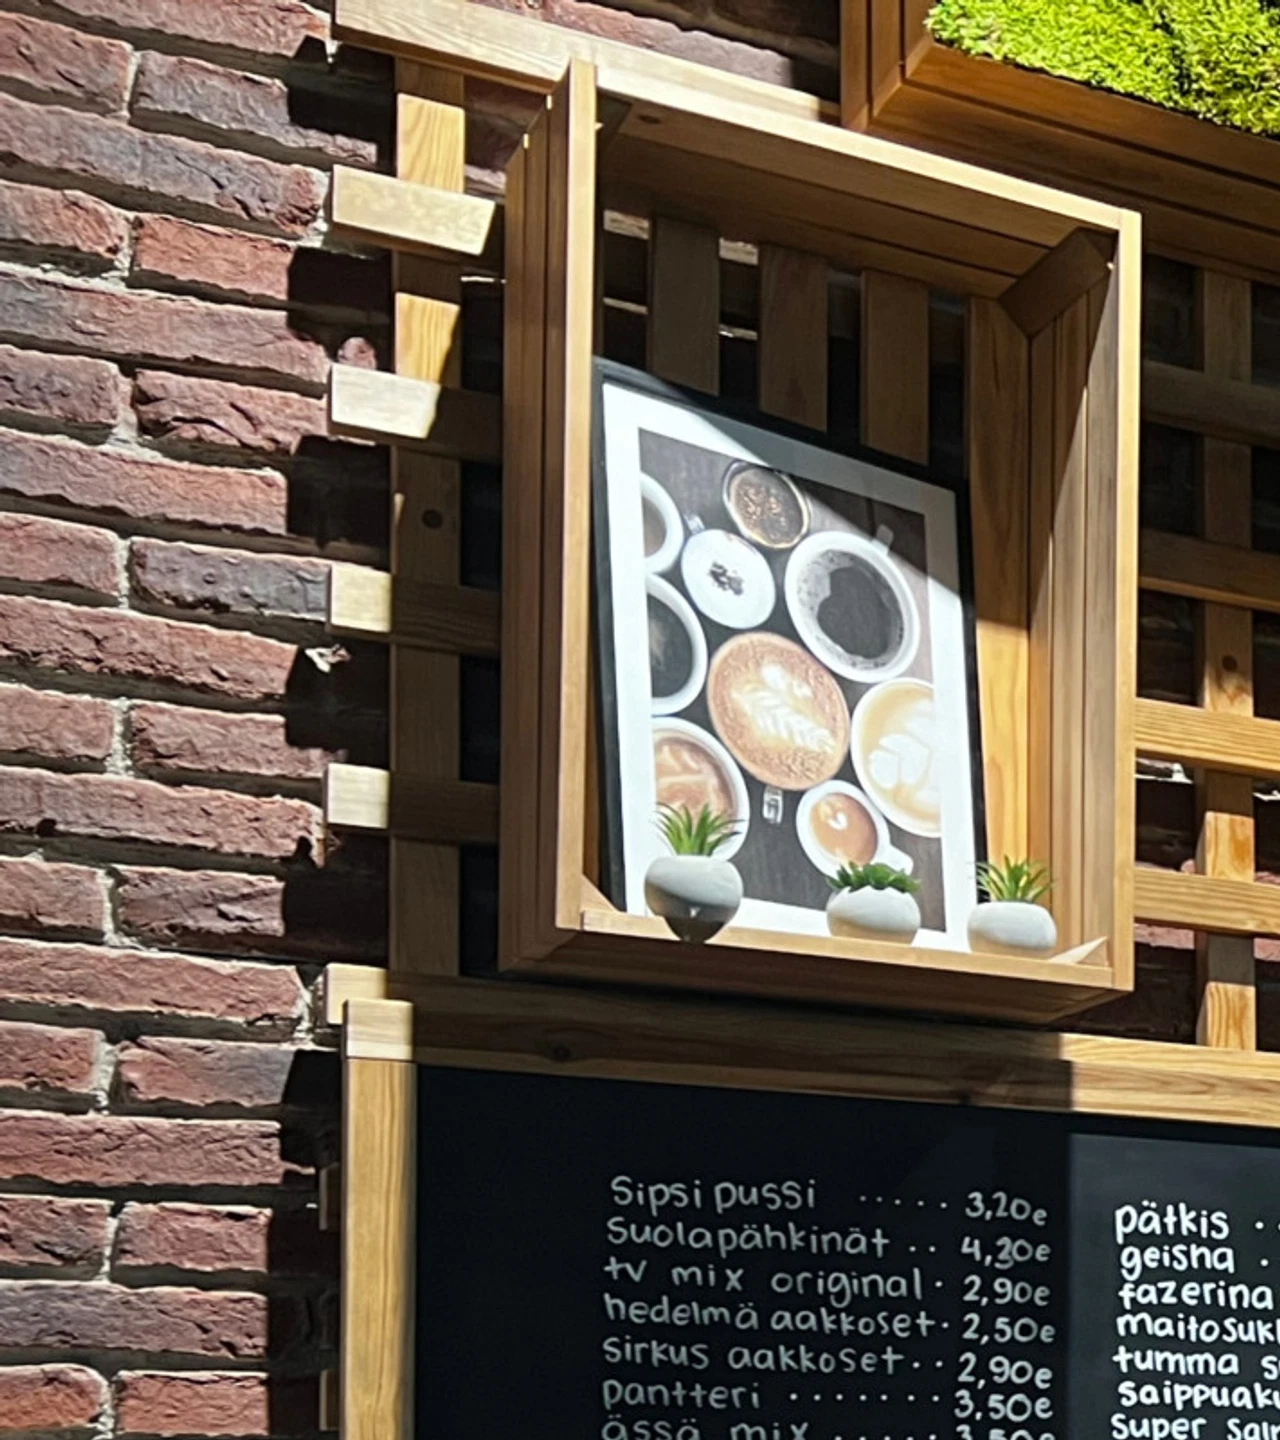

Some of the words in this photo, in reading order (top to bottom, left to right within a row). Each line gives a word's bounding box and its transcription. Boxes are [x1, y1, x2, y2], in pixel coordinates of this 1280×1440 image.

[964, 1190, 1048, 1226] 3,20e
[1114, 1200, 1230, 1244] pätkis
[1120, 1242, 1235, 1279] geisha
[604, 1257, 647, 1282] tv
[671, 1262, 743, 1292] mix
[770, 1268, 923, 1307] original
[963, 1275, 1051, 1307] 2,90e
[1118, 1279, 1274, 1311] fazerina
[604, 1293, 758, 1330] hedelmä
[770, 1306, 936, 1337] aakkoset
[962, 1314, 1056, 1345] 2,50e
[728, 1345, 904, 1374] aakkoset
[957, 1352, 1053, 1389] 2,90e
[1112, 1345, 1240, 1375] tumma
[603, 1379, 760, 1410] pantteri
[953, 1389, 1053, 1421] 3,50e
